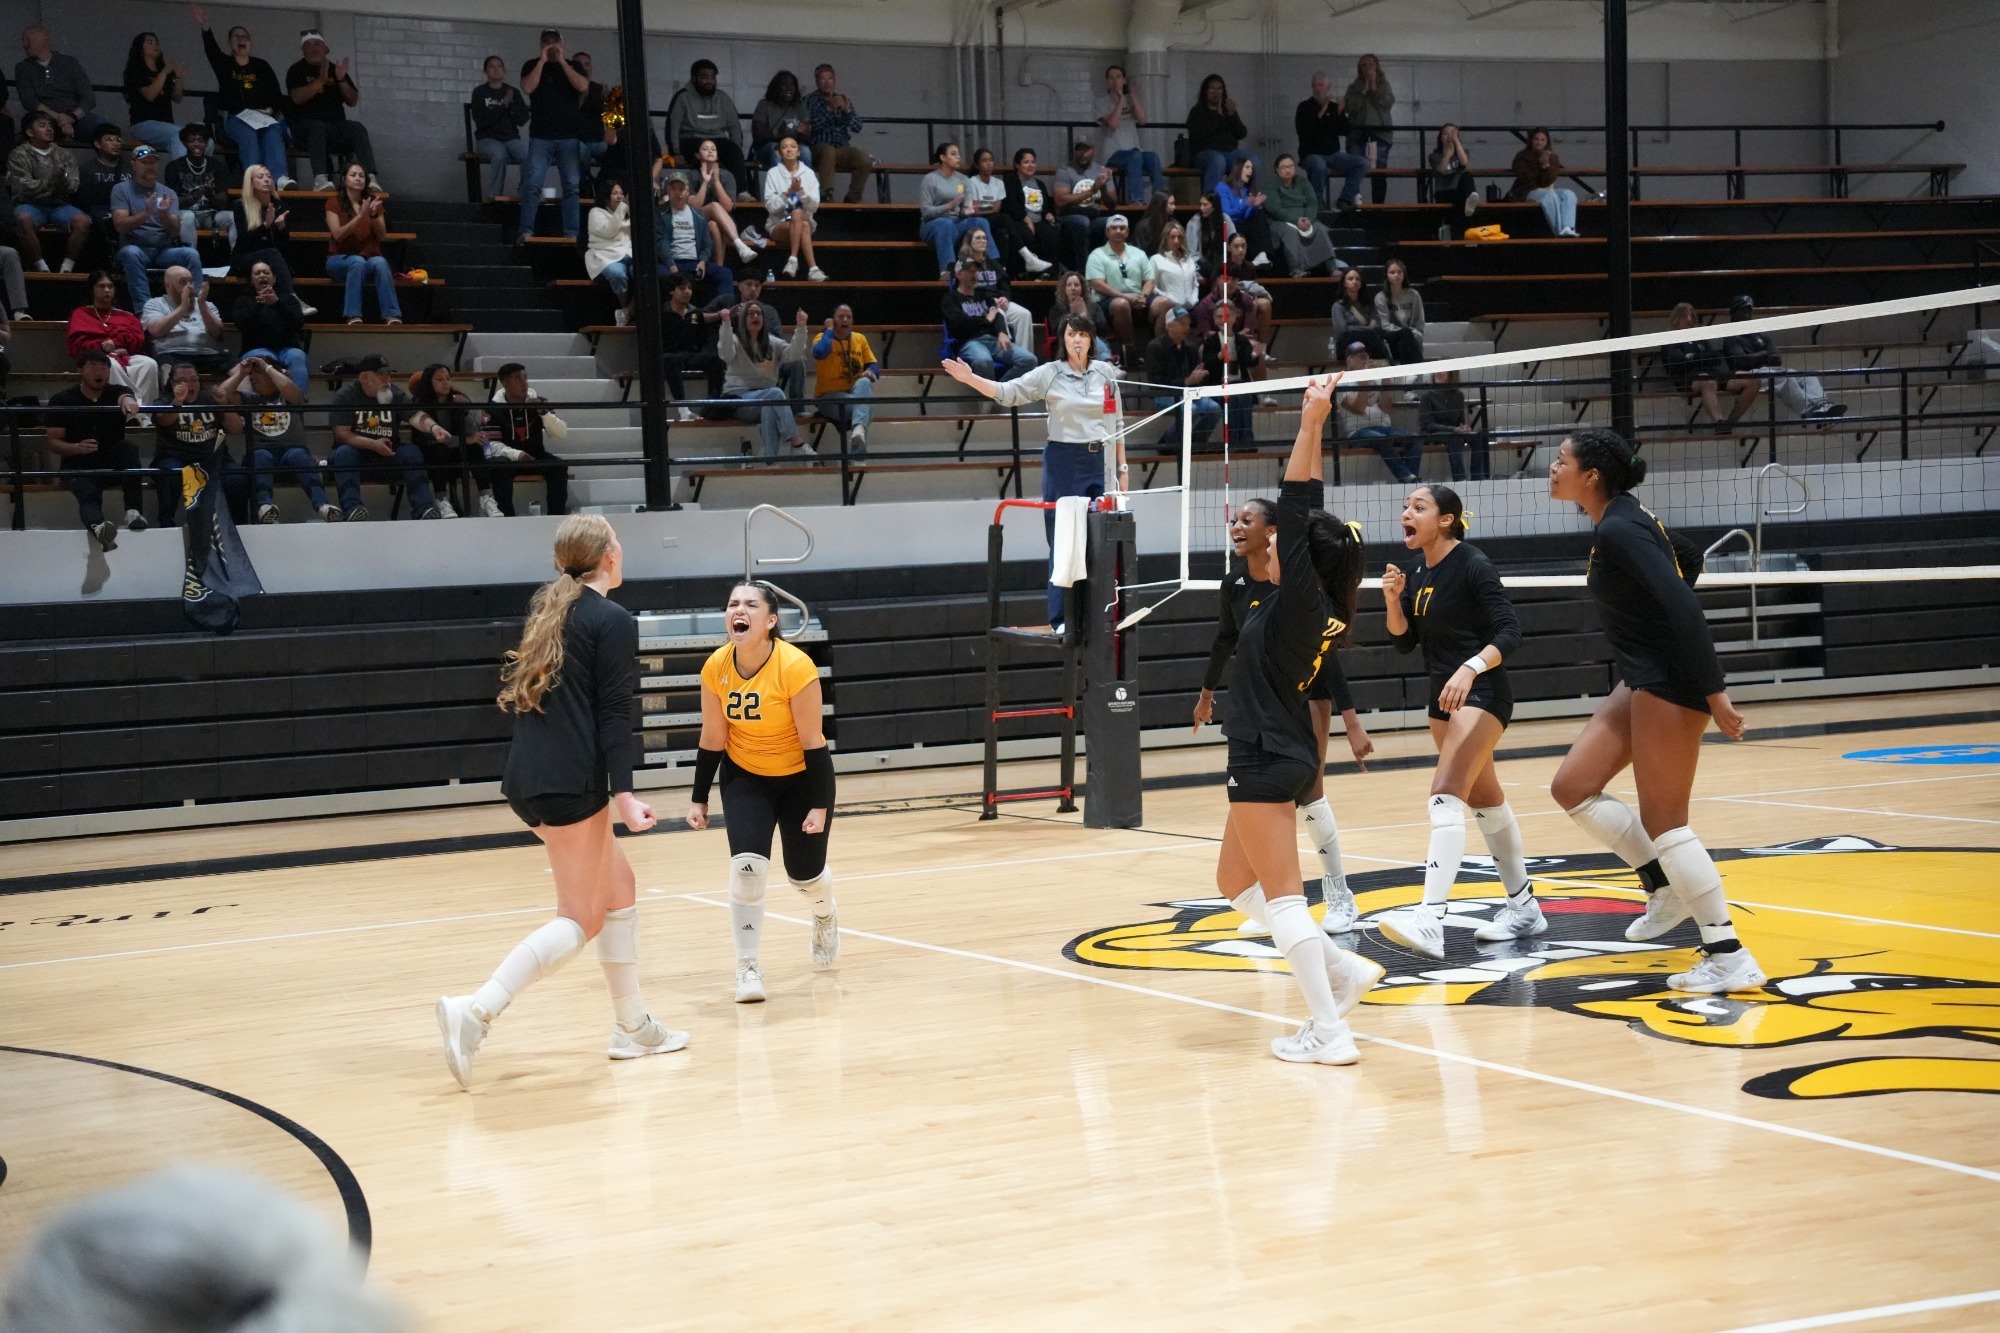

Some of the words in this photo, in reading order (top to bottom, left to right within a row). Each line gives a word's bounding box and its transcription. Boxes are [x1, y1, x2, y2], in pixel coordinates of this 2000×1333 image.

[356, 425, 392, 437] LDOGS
[1413, 586, 1435, 617] 17
[726, 691, 762, 721] 22
